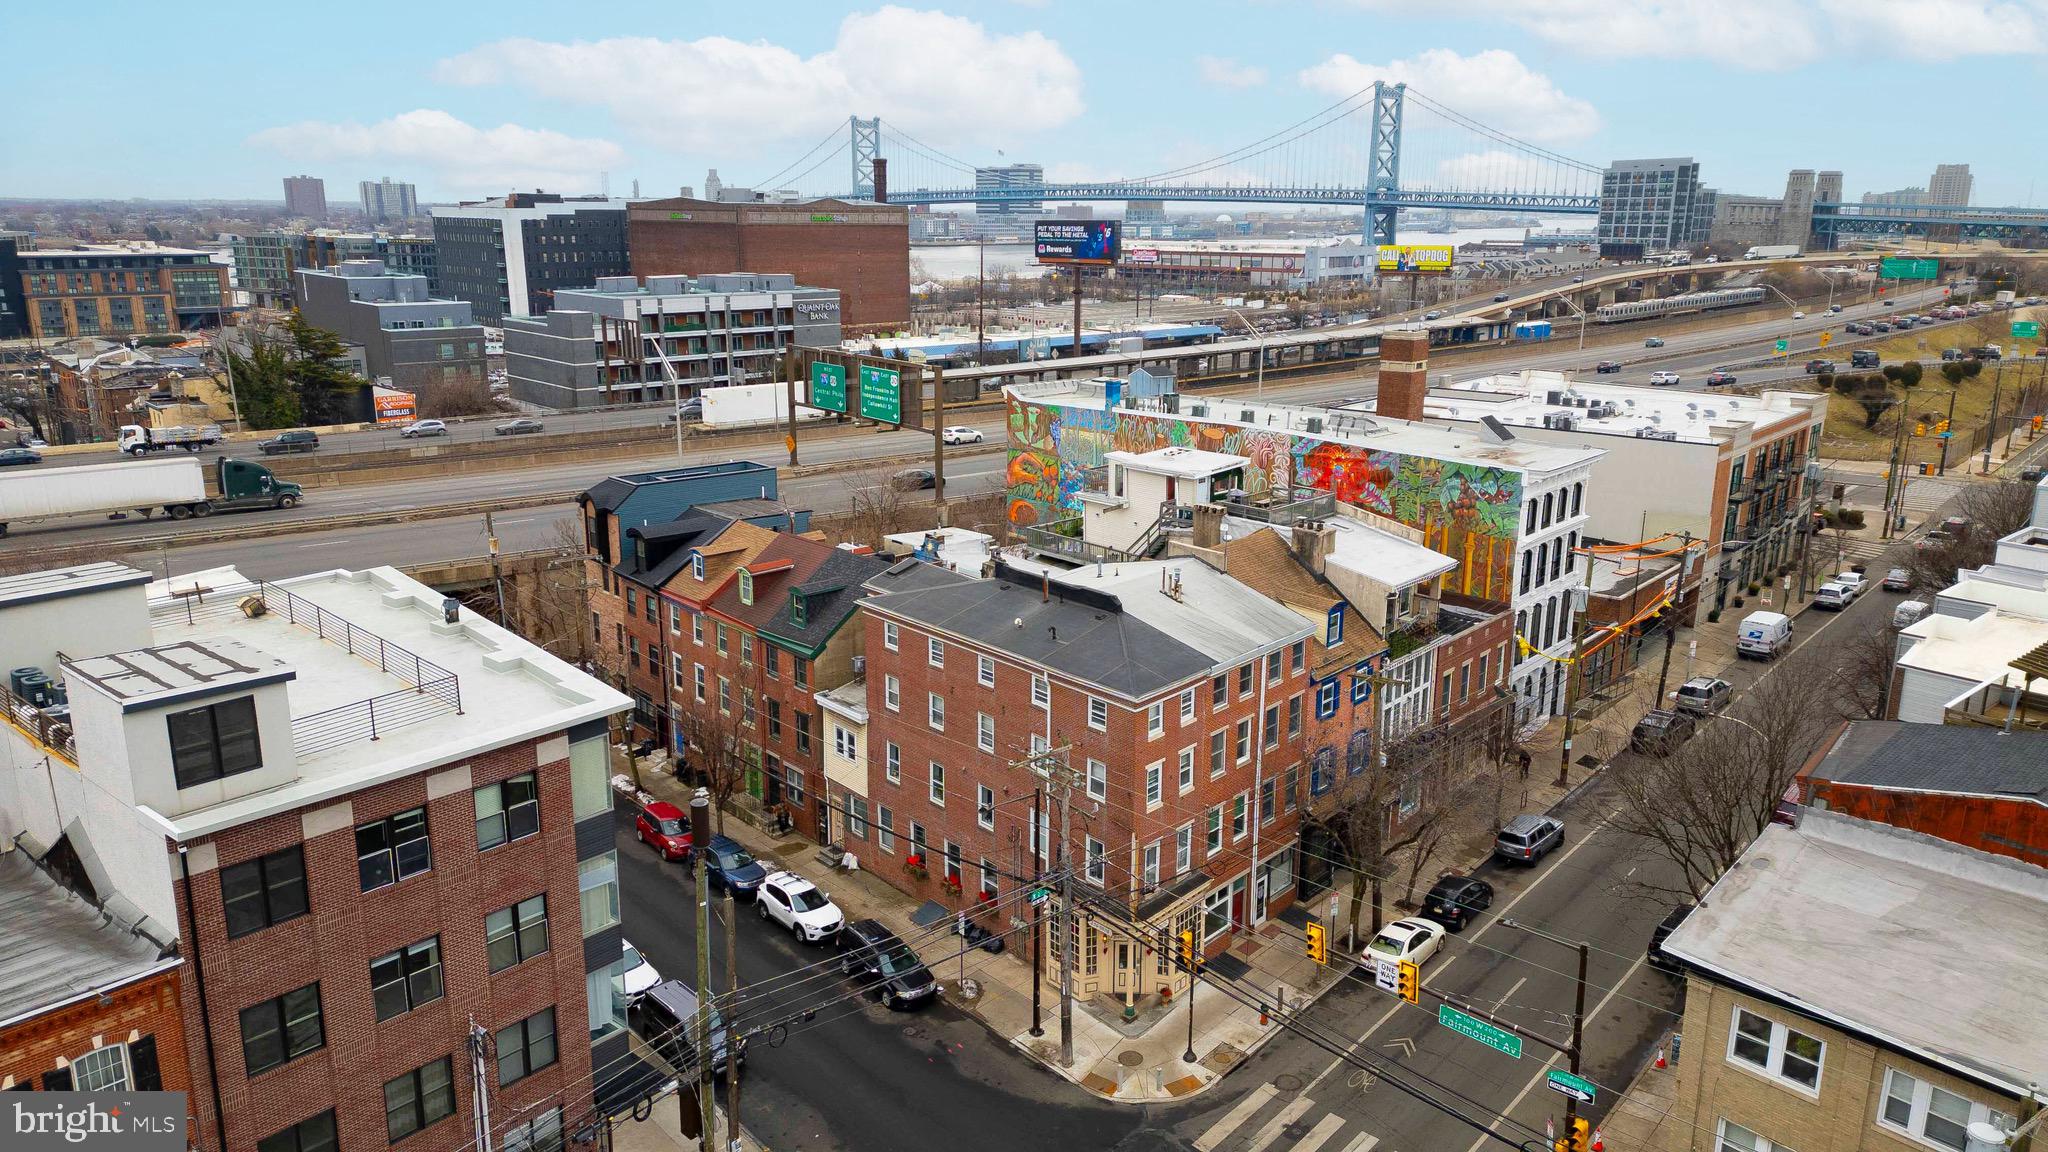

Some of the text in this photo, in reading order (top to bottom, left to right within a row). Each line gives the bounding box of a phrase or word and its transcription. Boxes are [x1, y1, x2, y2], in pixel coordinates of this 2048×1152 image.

[1046, 245, 1072, 253] Rewards
[1416, 250, 1448, 262] TOPDOG
[797, 302, 840, 313] QUAINT OAK
[810, 312, 829, 320] BANK
[814, 387, 831, 396] Central
[872, 385, 890, 394] Franklin
[861, 391, 889, 402] Independence
[867, 400, 887, 409] Callowhill
[1381, 963, 1396, 974] ONE
[1380, 971, 1396, 982] WAY
[1475, 1021, 1484, 1030] W
[1484, 1025, 1498, 1036] 200
[1442, 1015, 1518, 1054] Fairmount Av
[1550, 1072, 1583, 1090] Fairmount
[1565, 1088, 1578, 1096] WAY
